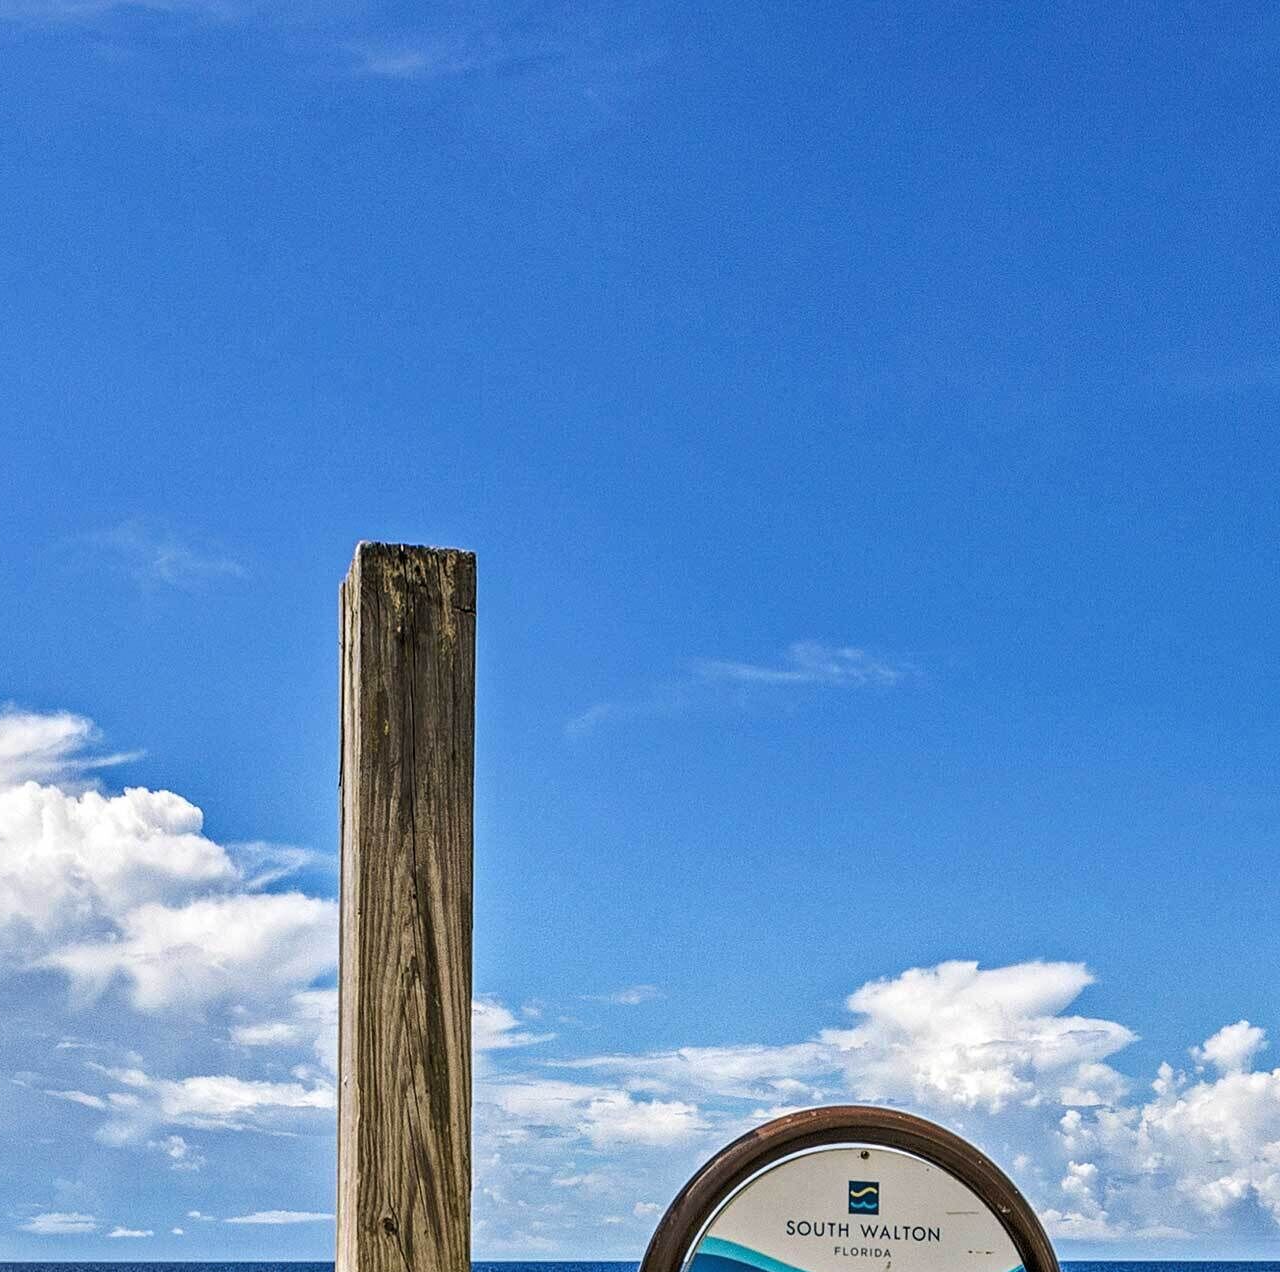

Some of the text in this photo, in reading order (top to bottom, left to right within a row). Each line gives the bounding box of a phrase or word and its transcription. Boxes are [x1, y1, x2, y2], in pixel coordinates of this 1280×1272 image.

[786, 1220, 940, 1242] SOUTH WALTON
[834, 1247, 891, 1258] FLORIDA
